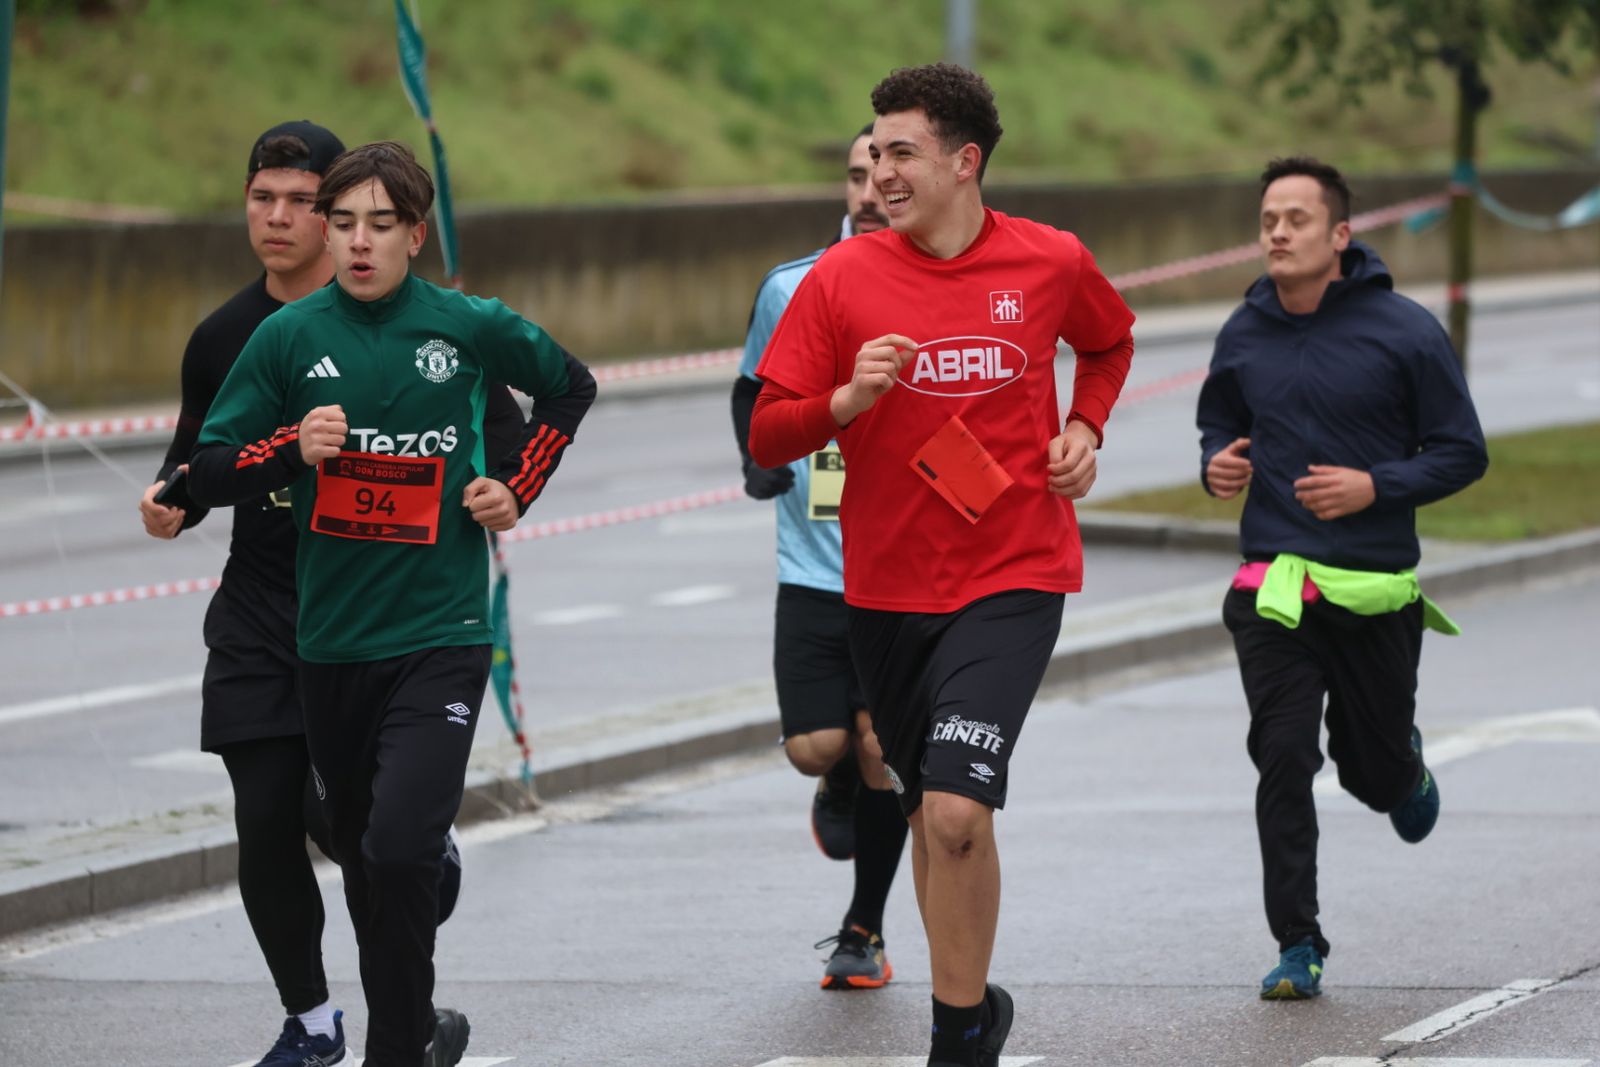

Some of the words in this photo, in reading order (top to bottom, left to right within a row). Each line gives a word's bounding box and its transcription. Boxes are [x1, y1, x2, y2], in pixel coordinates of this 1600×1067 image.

[418, 342, 455, 357] MANCHESTER
[911, 346, 1014, 384] ABRIL
[426, 371, 451, 380] UNITED
[349, 425, 459, 458] Tezos
[355, 466, 374, 476] DON
[376, 469, 406, 479] BOSCO
[355, 487, 396, 517] 94
[968, 771, 991, 784] umbro
